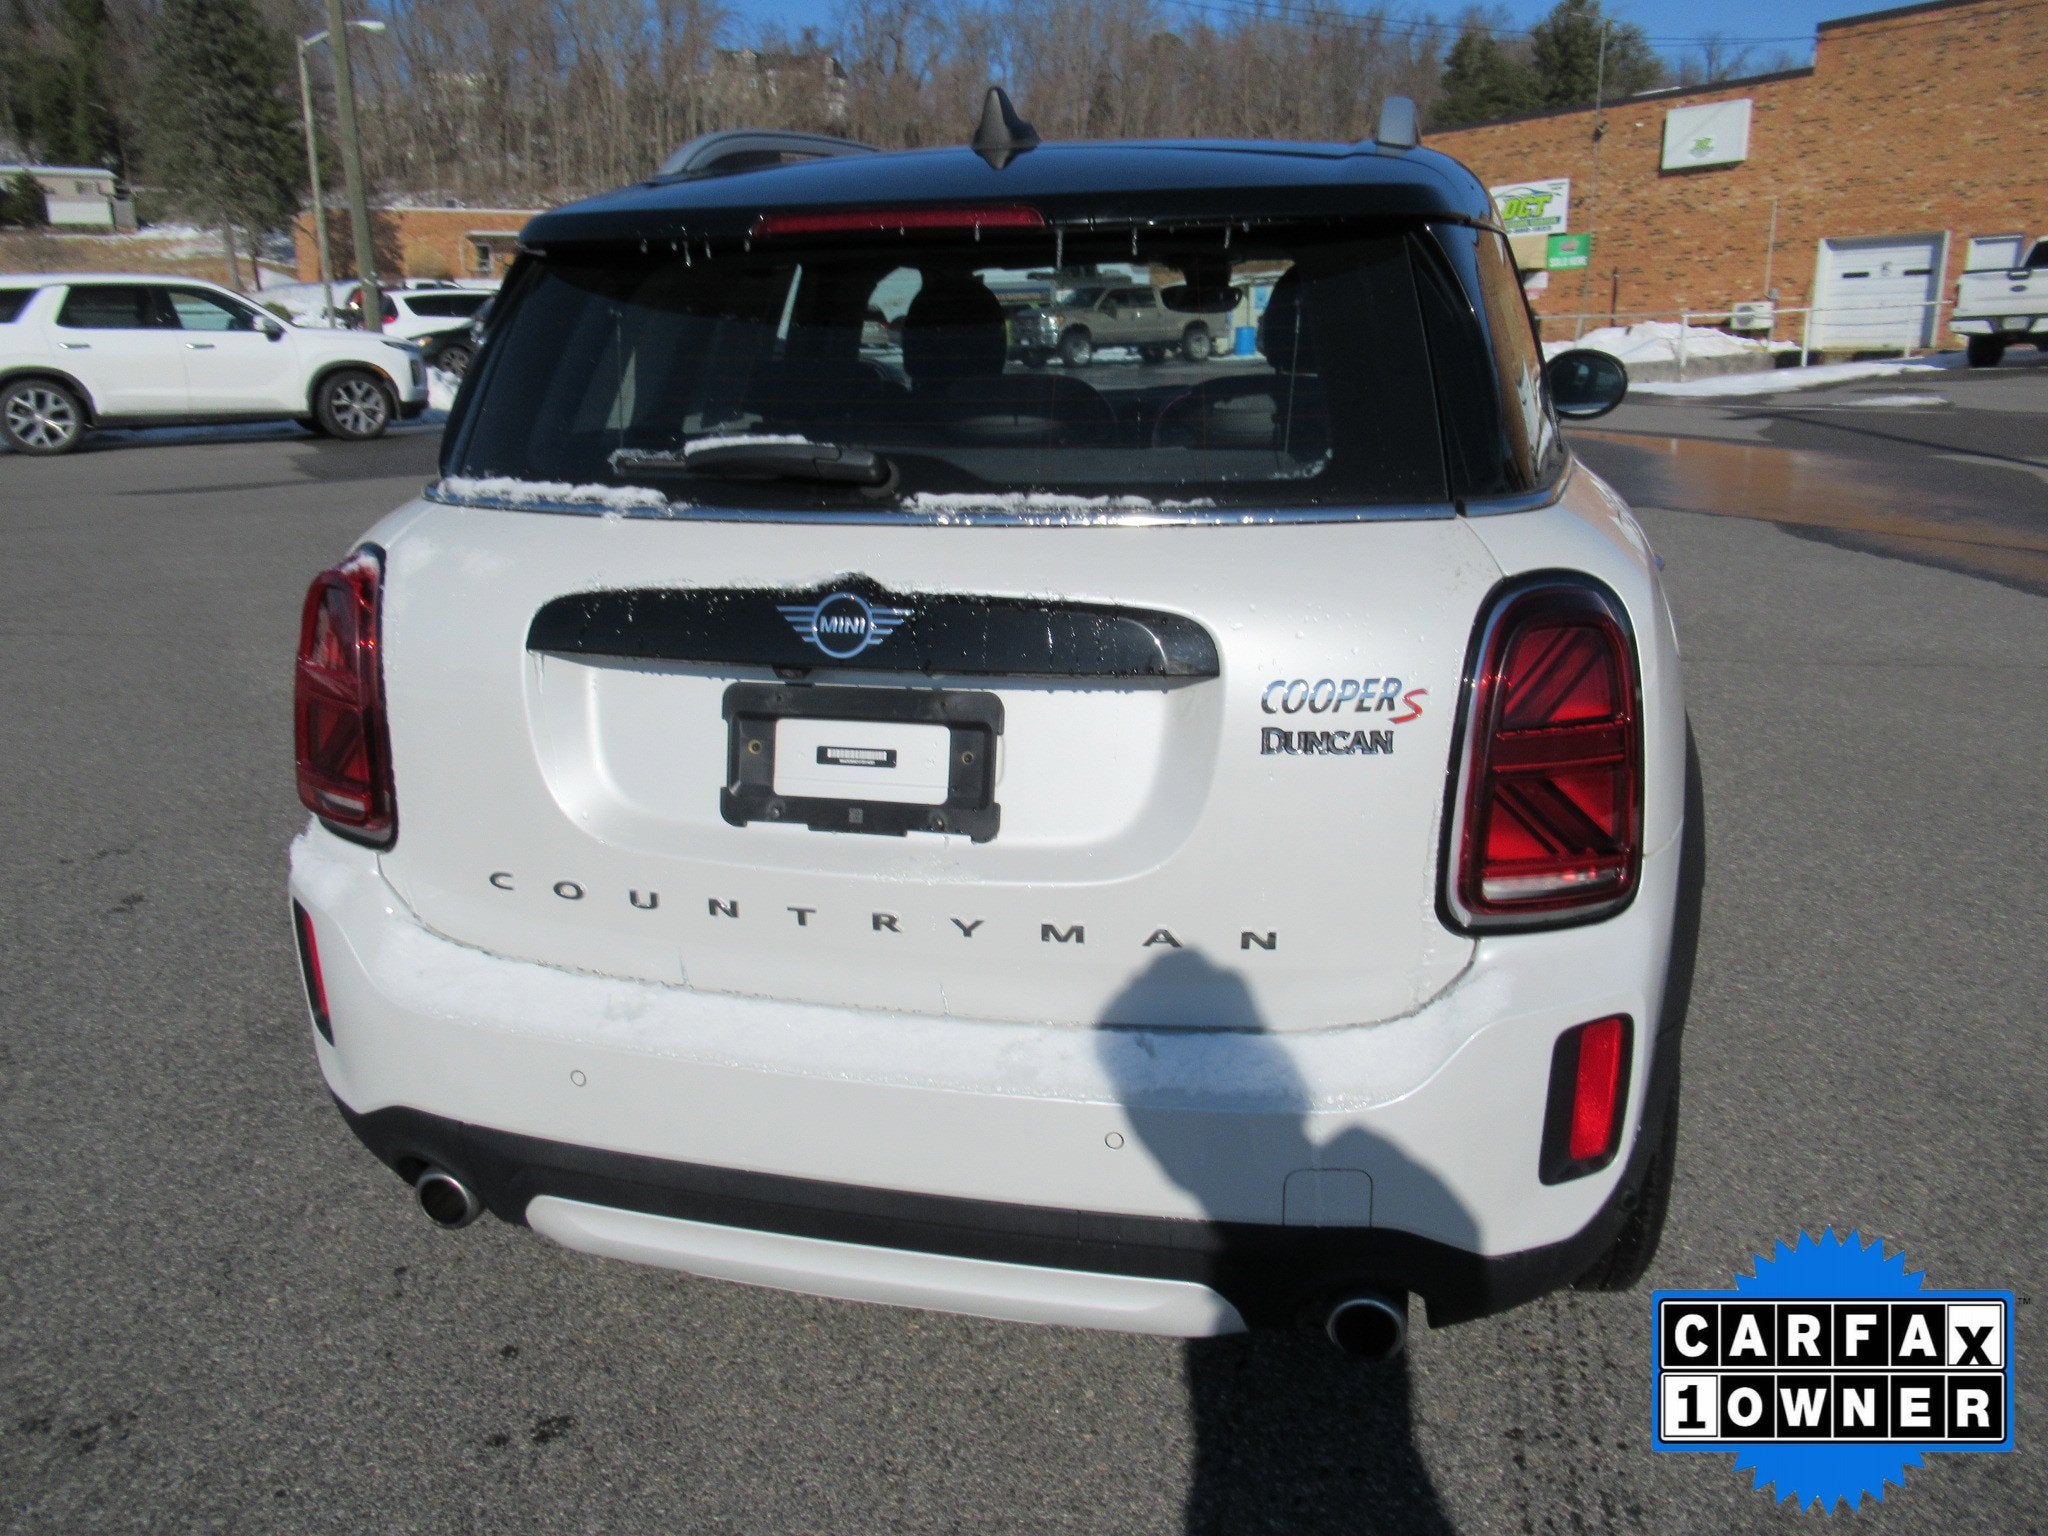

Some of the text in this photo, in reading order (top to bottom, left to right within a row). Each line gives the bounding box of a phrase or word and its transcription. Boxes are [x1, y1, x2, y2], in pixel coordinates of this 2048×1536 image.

[820, 616, 865, 633] MINI
[1261, 677, 1403, 714] COOPER
[1261, 727, 1394, 755] DUNCAN
[489, 871, 1277, 950] COUNTRYMAN
